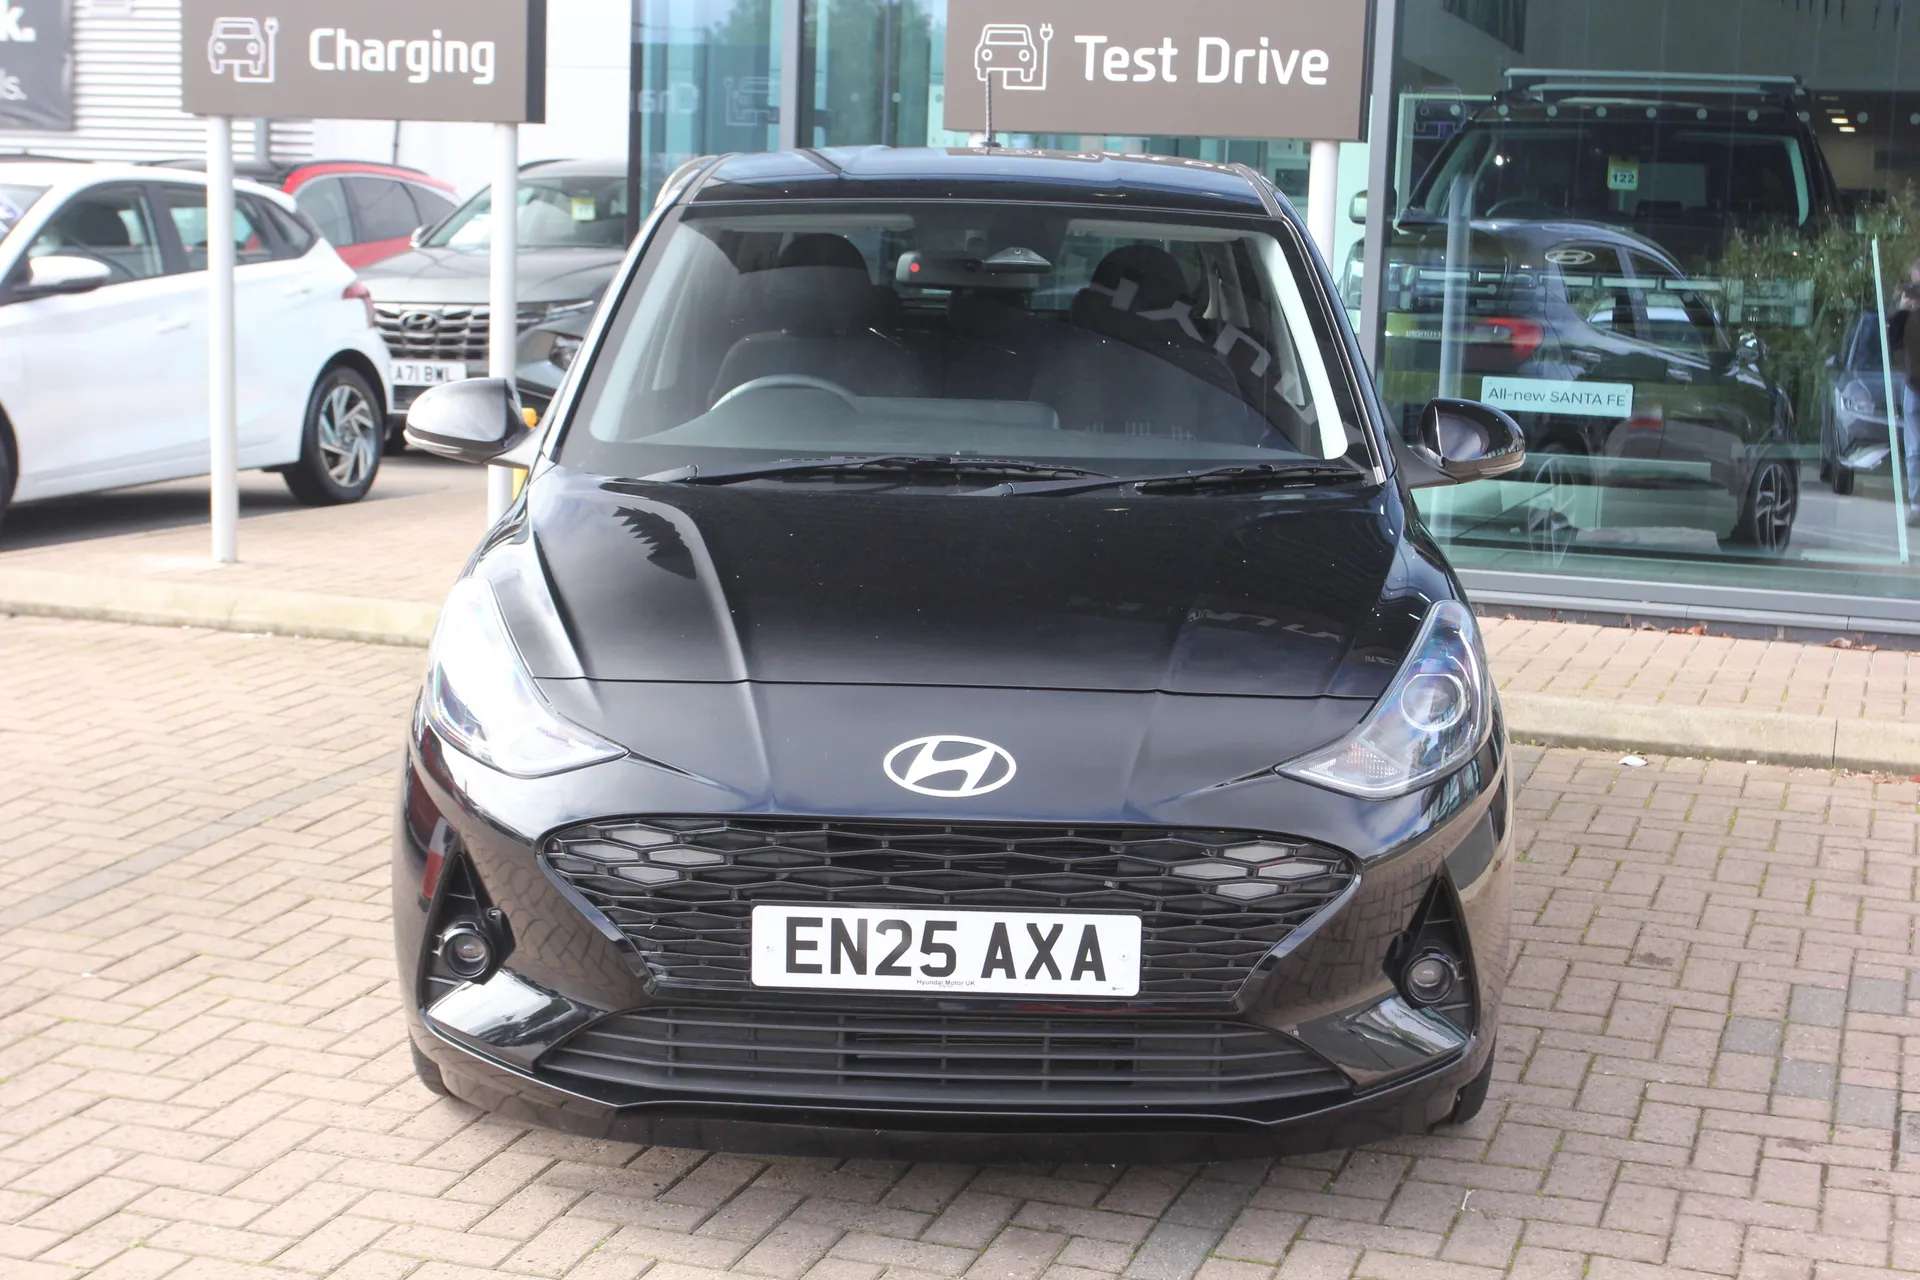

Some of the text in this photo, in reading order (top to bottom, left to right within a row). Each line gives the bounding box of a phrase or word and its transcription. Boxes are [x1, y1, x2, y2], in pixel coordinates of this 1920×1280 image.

[308, 27, 496, 85] Charging
[1073, 34, 1330, 86] Test Drive
[1613, 173, 1635, 184] 122
[1488, 386, 1626, 407] All-new SANTA FE
[785, 916, 1107, 982] EN25 AXA
[916, 979, 943, 987] Hyundai
